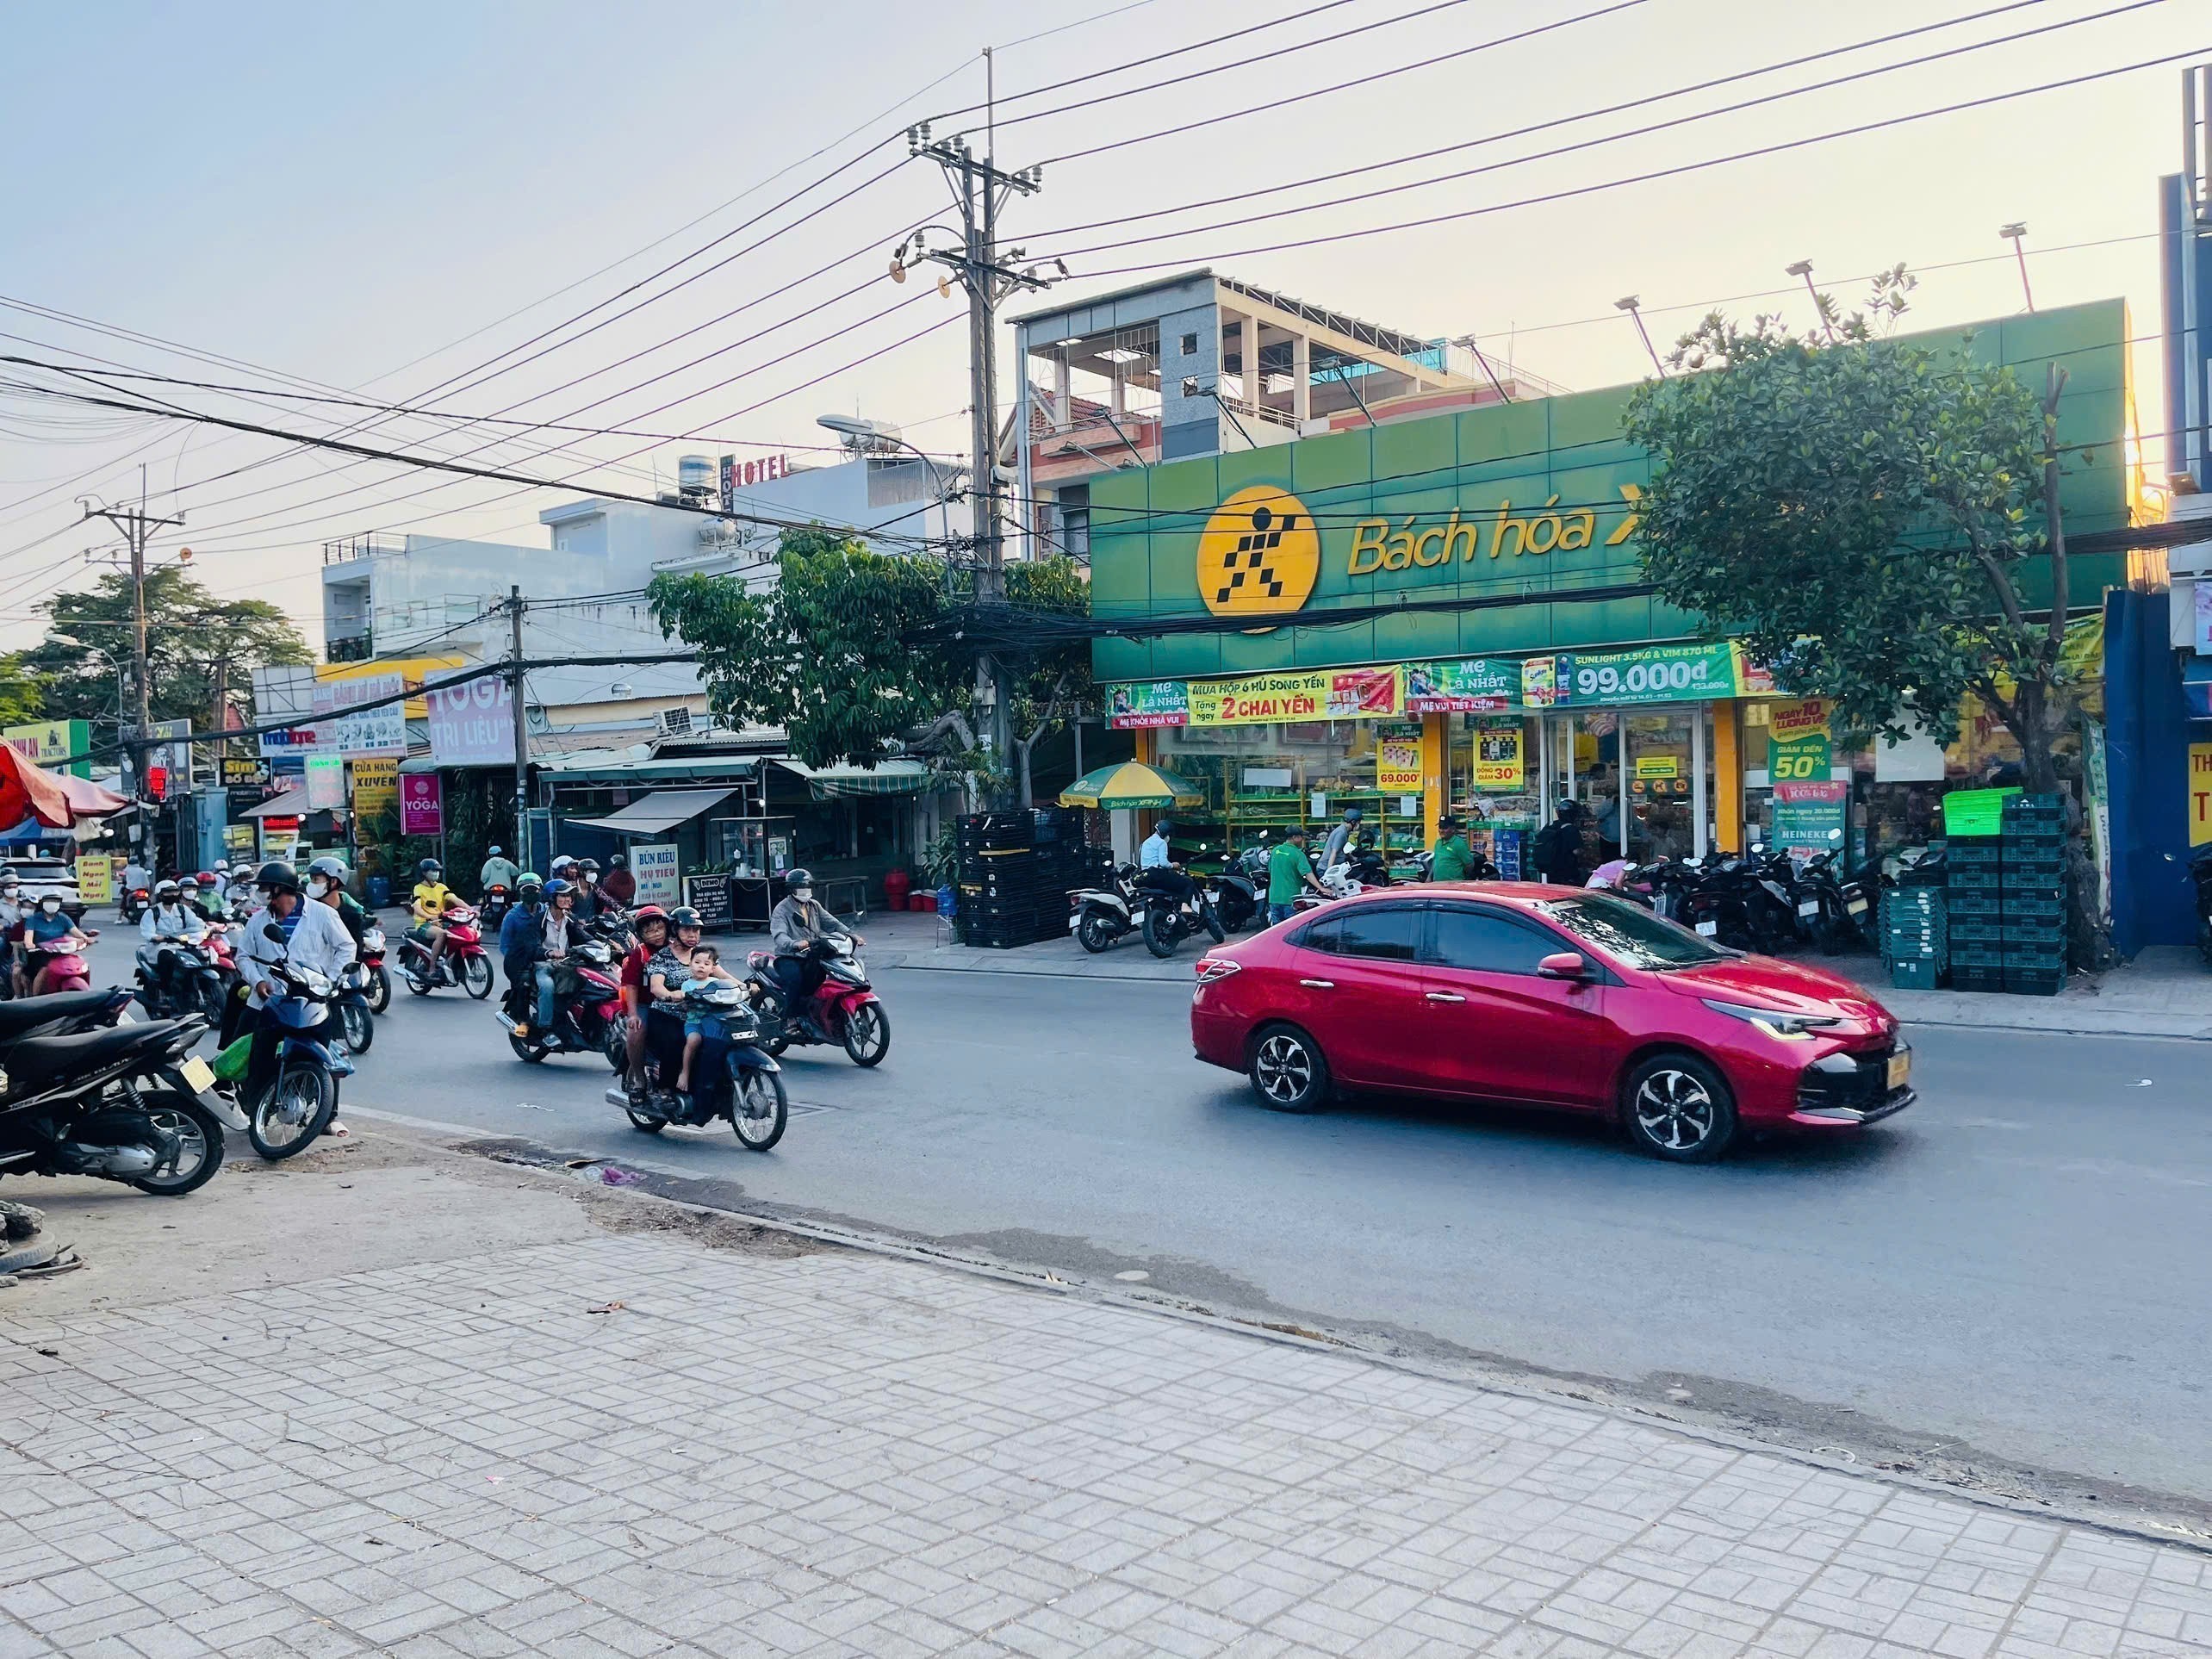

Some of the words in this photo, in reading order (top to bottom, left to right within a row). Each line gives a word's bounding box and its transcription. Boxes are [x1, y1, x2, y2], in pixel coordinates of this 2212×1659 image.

[731, 454, 788, 488] HOTEL
[1348, 506, 1477, 575] Bách
[1490, 494, 1596, 558] hóa
[1575, 654, 1621, 664] SUNLIGHT
[1624, 650, 1651, 661] 3.5KG
[1662, 649, 1681, 657] VIM
[1682, 647, 1702, 656] 870
[1193, 685, 1216, 695] MUA
[1219, 682, 1240, 695] HỘP
[1242, 682, 1249, 692] 6
[1252, 678, 1266, 691] HỦ
[1270, 679, 1300, 691] SONG
[1302, 674, 1325, 688] YẾN
[1577, 659, 1707, 695] 99.000đ
[1196, 700, 1215, 711] Tặng
[1221, 697, 1236, 718] 2
[1239, 699, 1277, 716] CHAI
[1281, 693, 1314, 714] YẾN
[1420, 701, 1434, 711] MẸ
[1451, 698, 1469, 710] TIẾT
[1471, 699, 1494, 711] KIỆM
[1774, 708, 1802, 720] NGÀY
[1802, 701, 1821, 716] 10
[1120, 718, 1129, 727] MẸ
[1150, 716, 1165, 724] NHÀ
[1196, 711, 1215, 721] ngay
[224, 761, 256, 773] Sim
[355, 760, 371, 773] CỬA
[1494, 767, 1520, 779] 30%
[1774, 756, 1825, 778] 50%
[406, 800, 438, 810] YOGA
[639, 850, 655, 865] BÚN
[657, 848, 674, 864] RIÊU
